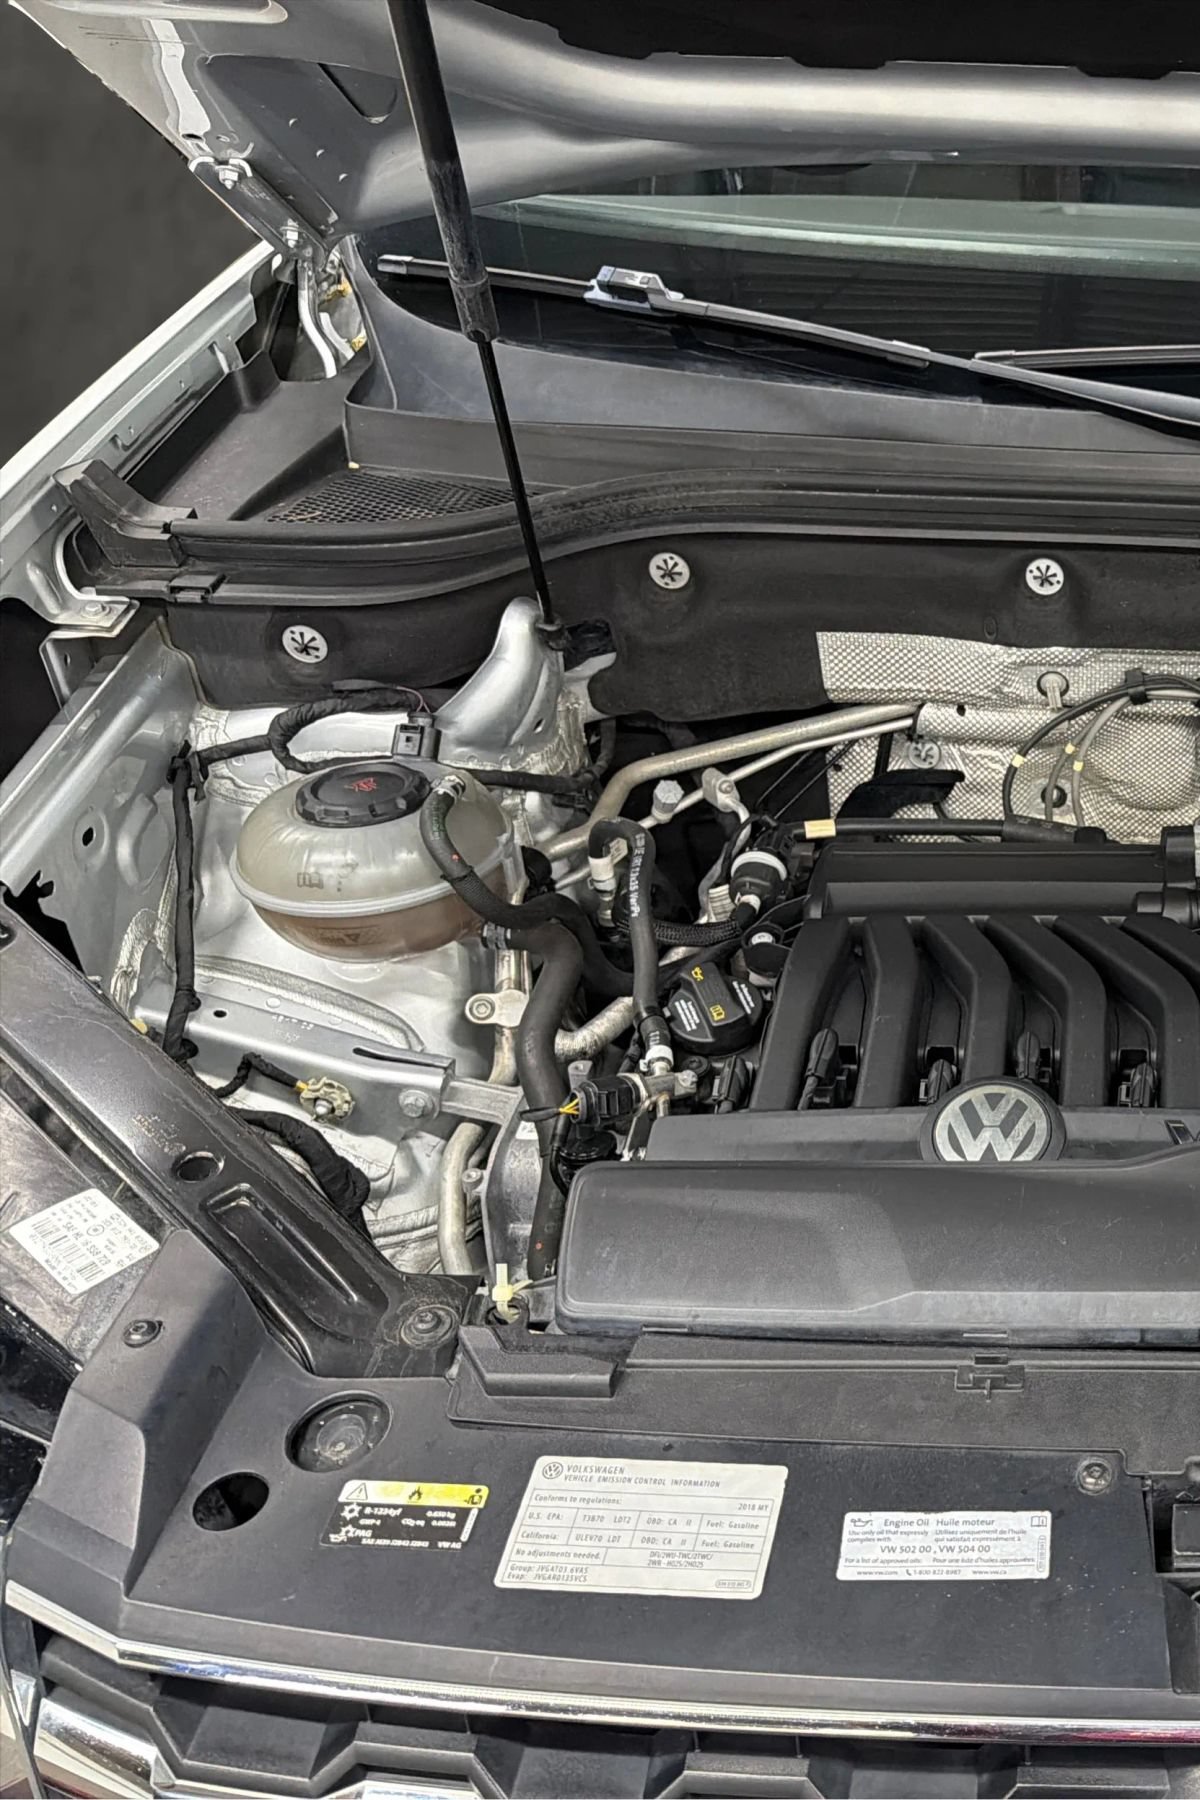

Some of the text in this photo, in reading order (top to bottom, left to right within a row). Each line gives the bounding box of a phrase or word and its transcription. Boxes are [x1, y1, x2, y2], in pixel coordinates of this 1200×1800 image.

[567, 1464, 625, 1474] VOLKSWAGEN
[564, 1474, 721, 1488] VEHICLE EMISSION CONTROL INFORMATION
[534, 1494, 568, 1503] Conforms
[570, 1495, 577, 1503] to
[738, 1503, 756, 1511] 2018
[706, 1520, 759, 1530] Fuel: Gasoline
[884, 1518, 914, 1528] Engine
[916, 1518, 930, 1526] Oil
[608, 1535, 622, 1543] LDT
[723, 1540, 755, 1549] Gasoline
[515, 1548, 600, 1559] No adjustments needed.
[880, 1545, 898, 1554] VW
[899, 1545, 917, 1554] 502
[918, 1545, 932, 1554] 00
[938, 1545, 955, 1554] VW
[958, 1545, 976, 1554] 504
[978, 1545, 990, 1553] 00
[510, 1564, 534, 1573] Group:
